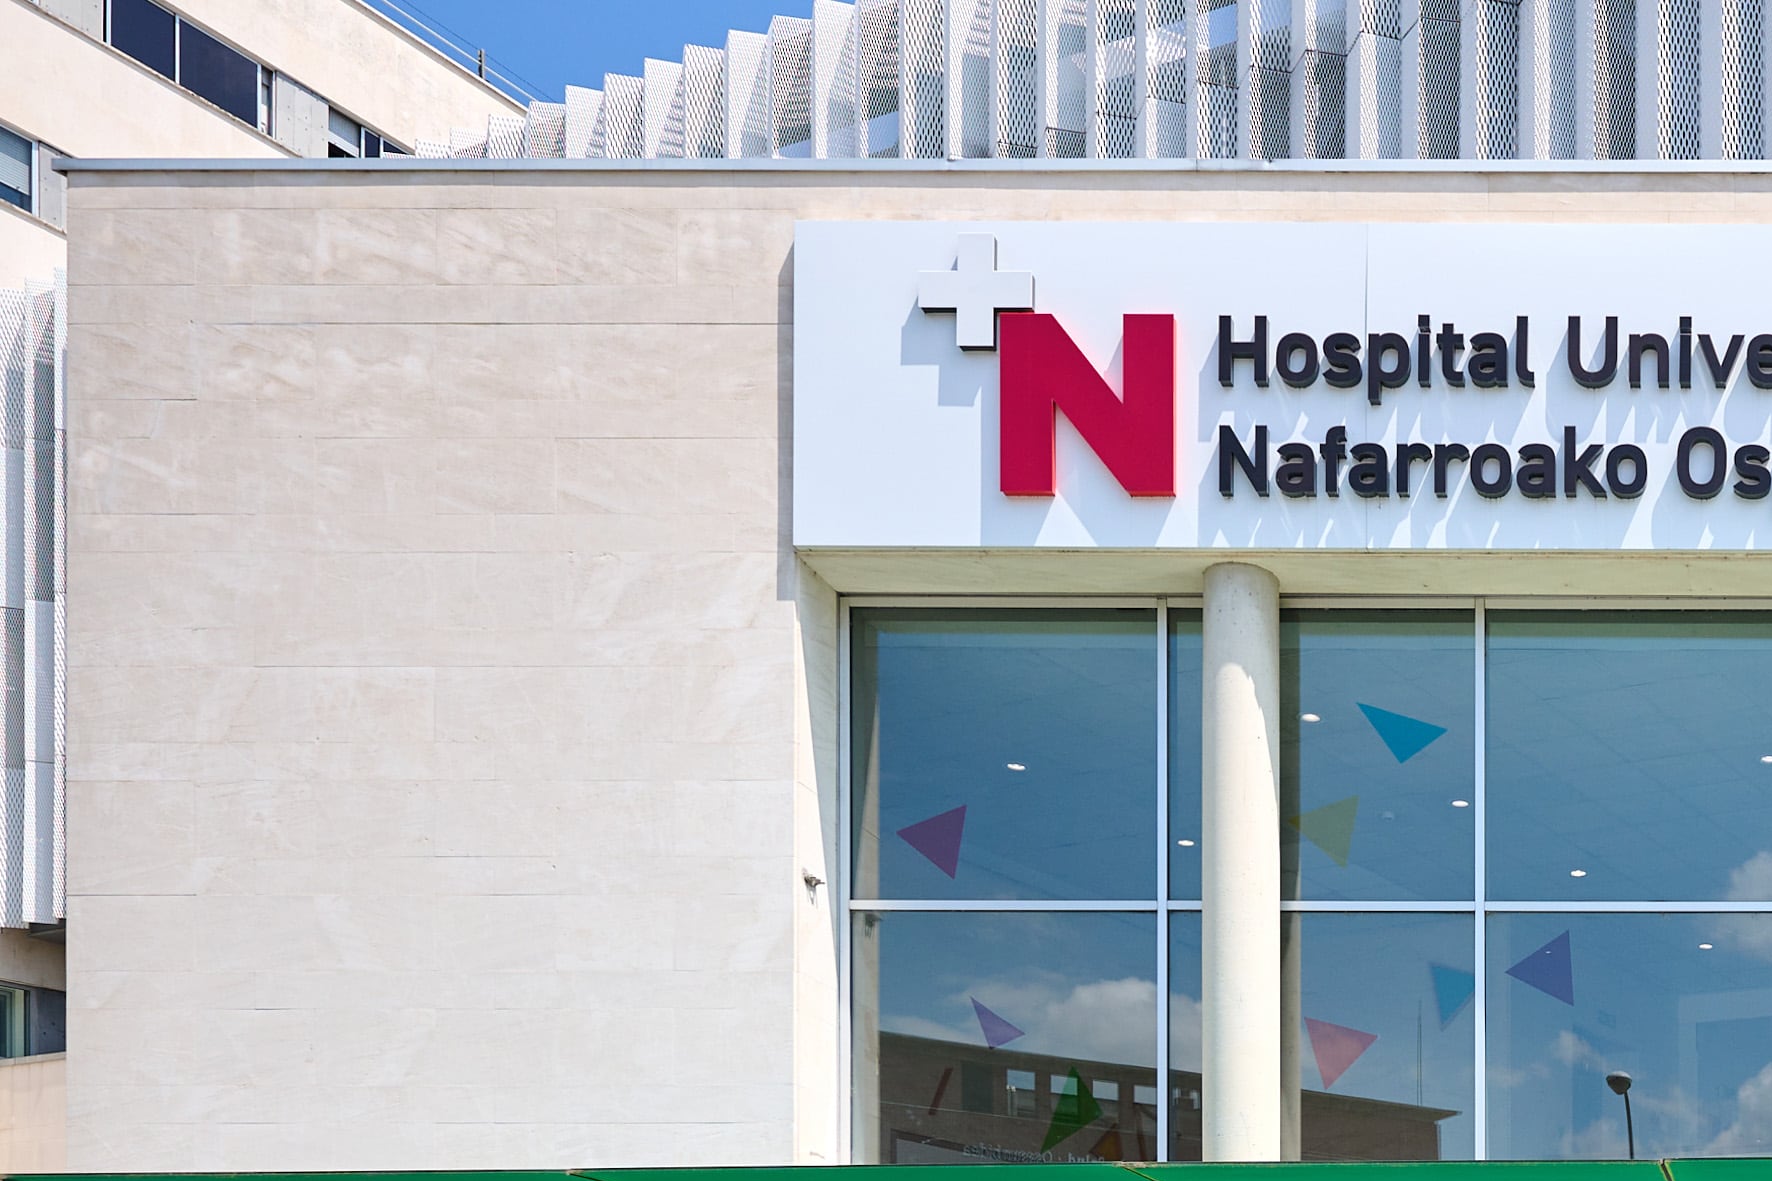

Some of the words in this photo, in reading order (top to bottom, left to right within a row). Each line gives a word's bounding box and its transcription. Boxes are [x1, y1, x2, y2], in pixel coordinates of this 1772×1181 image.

[1000, 312, 1176, 496] N
[1219, 315, 1535, 405] Hospital
[1219, 426, 1647, 499] Nafarroako
